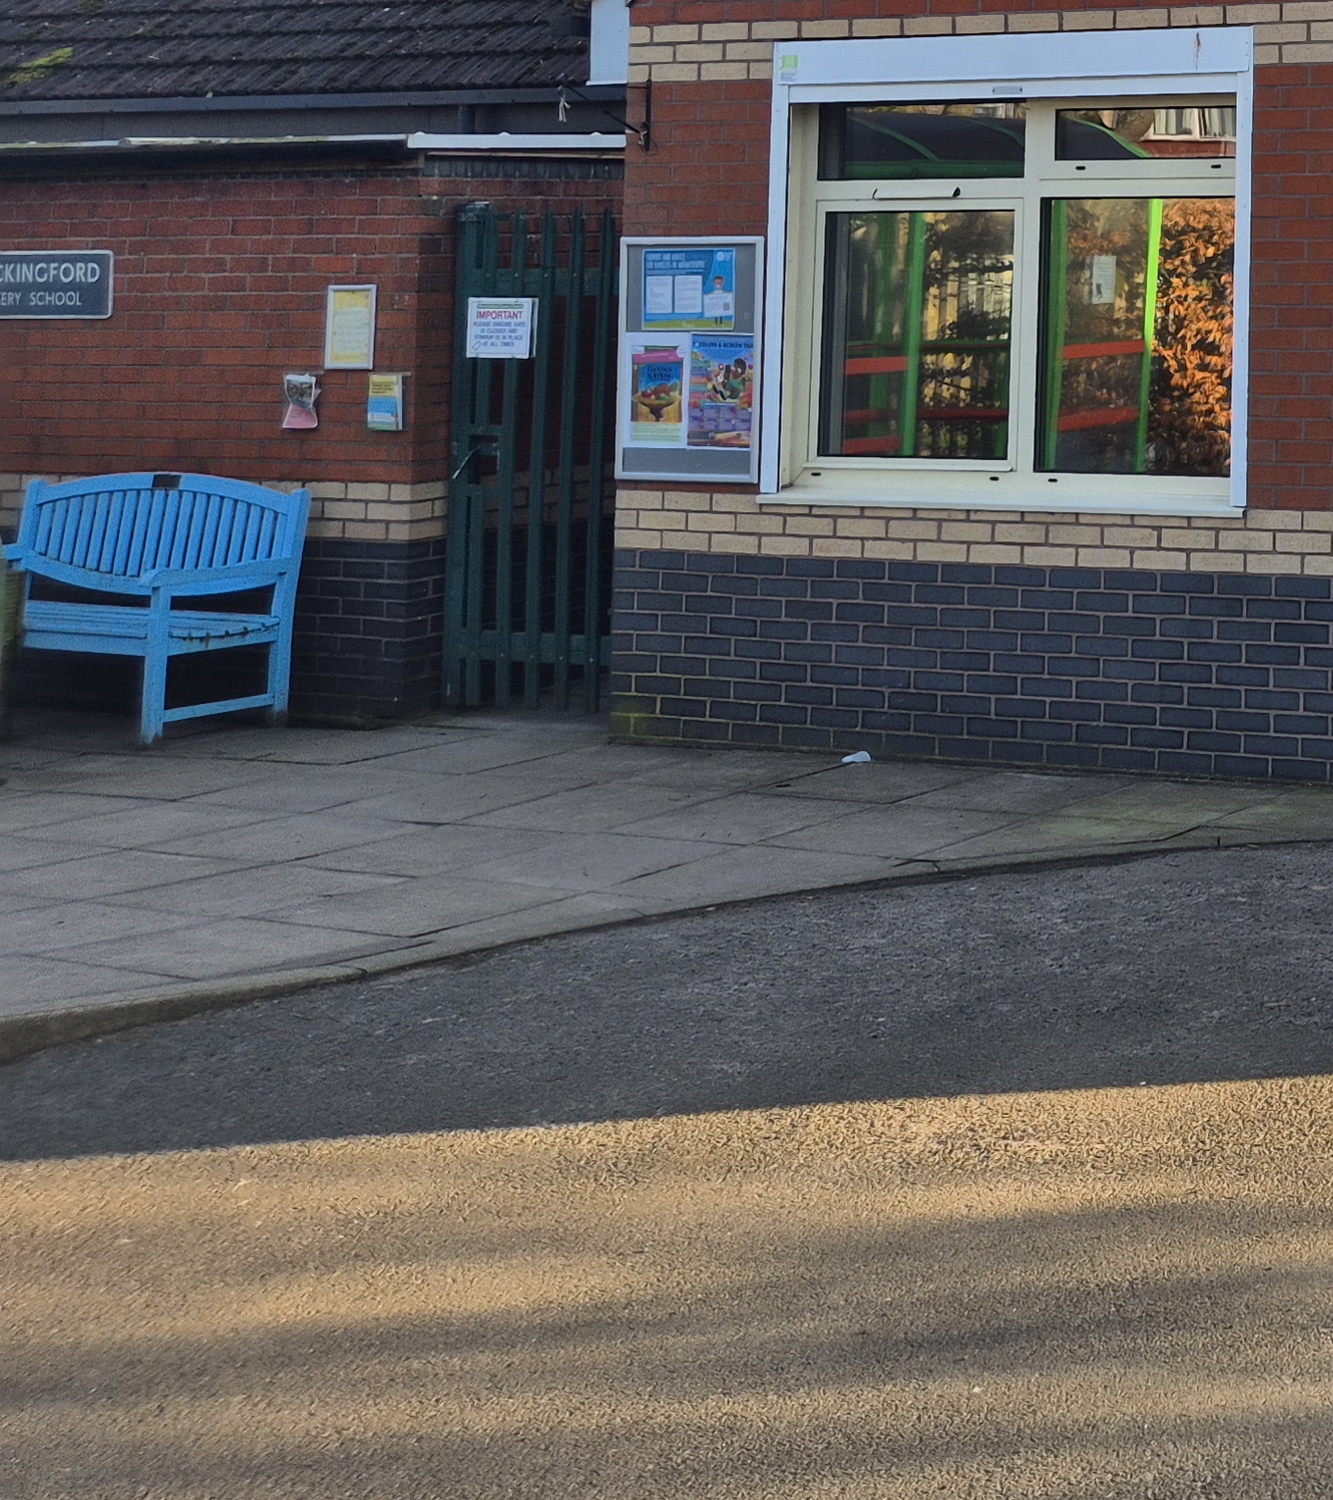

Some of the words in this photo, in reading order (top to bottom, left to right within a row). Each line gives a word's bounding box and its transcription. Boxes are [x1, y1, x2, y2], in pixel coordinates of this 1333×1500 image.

[0, 263, 100, 283] KINGFORD
[29, 291, 82, 306] SCHOOL
[476, 311, 523, 319] IMPORTANT
